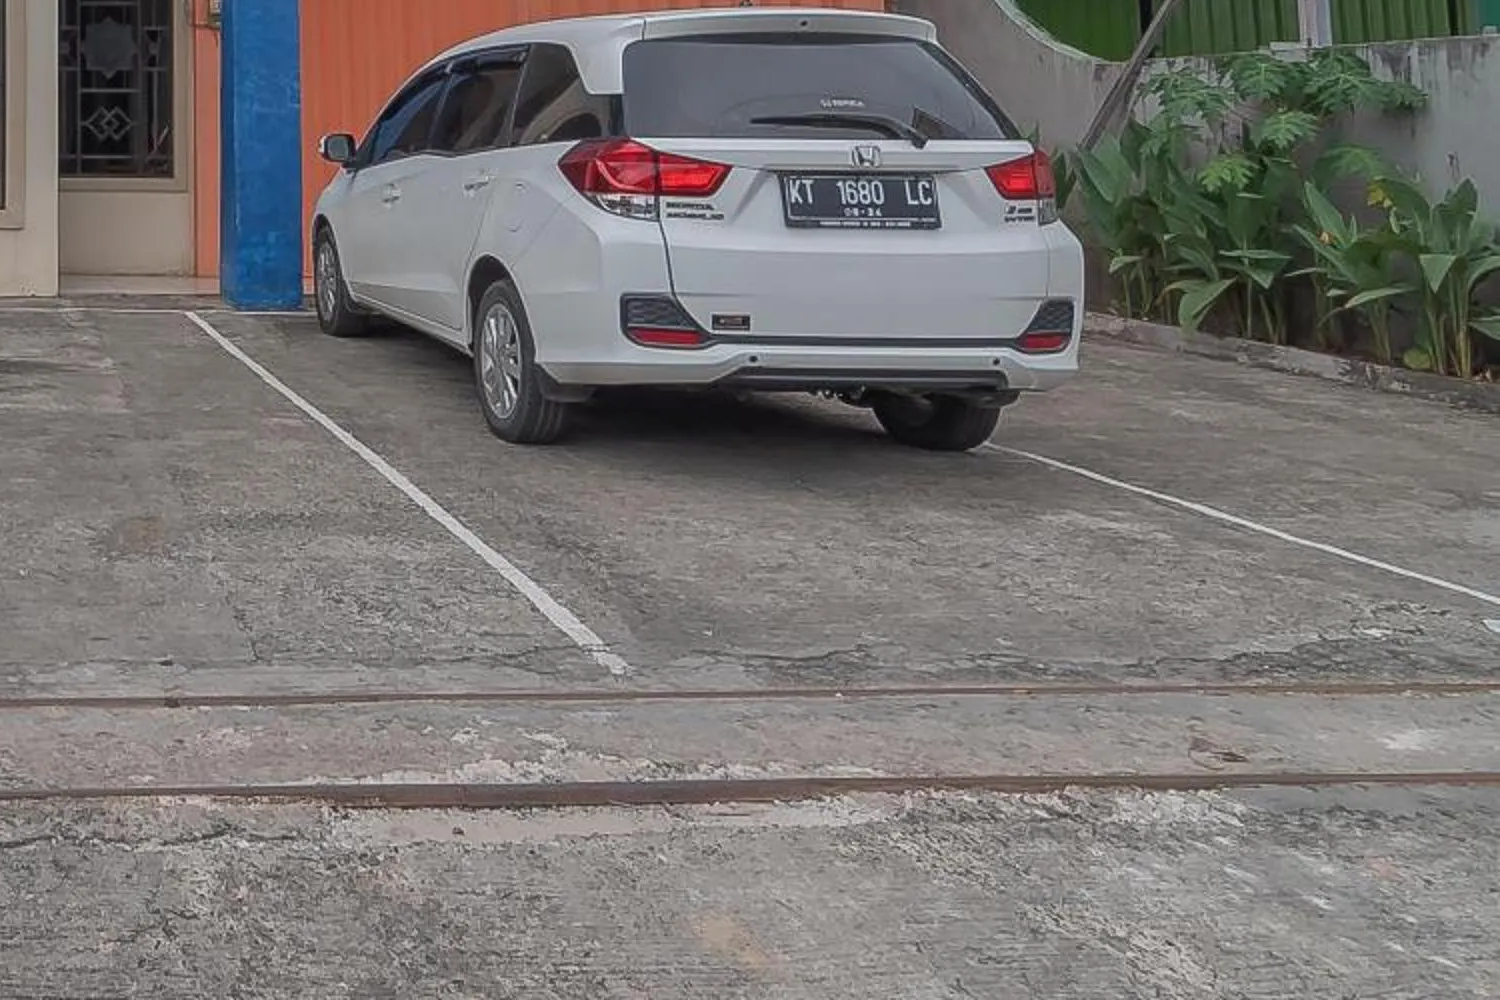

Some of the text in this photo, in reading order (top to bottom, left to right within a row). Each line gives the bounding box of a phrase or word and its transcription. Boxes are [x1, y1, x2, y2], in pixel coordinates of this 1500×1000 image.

[789, 179, 933, 205] KT 1680 LC
